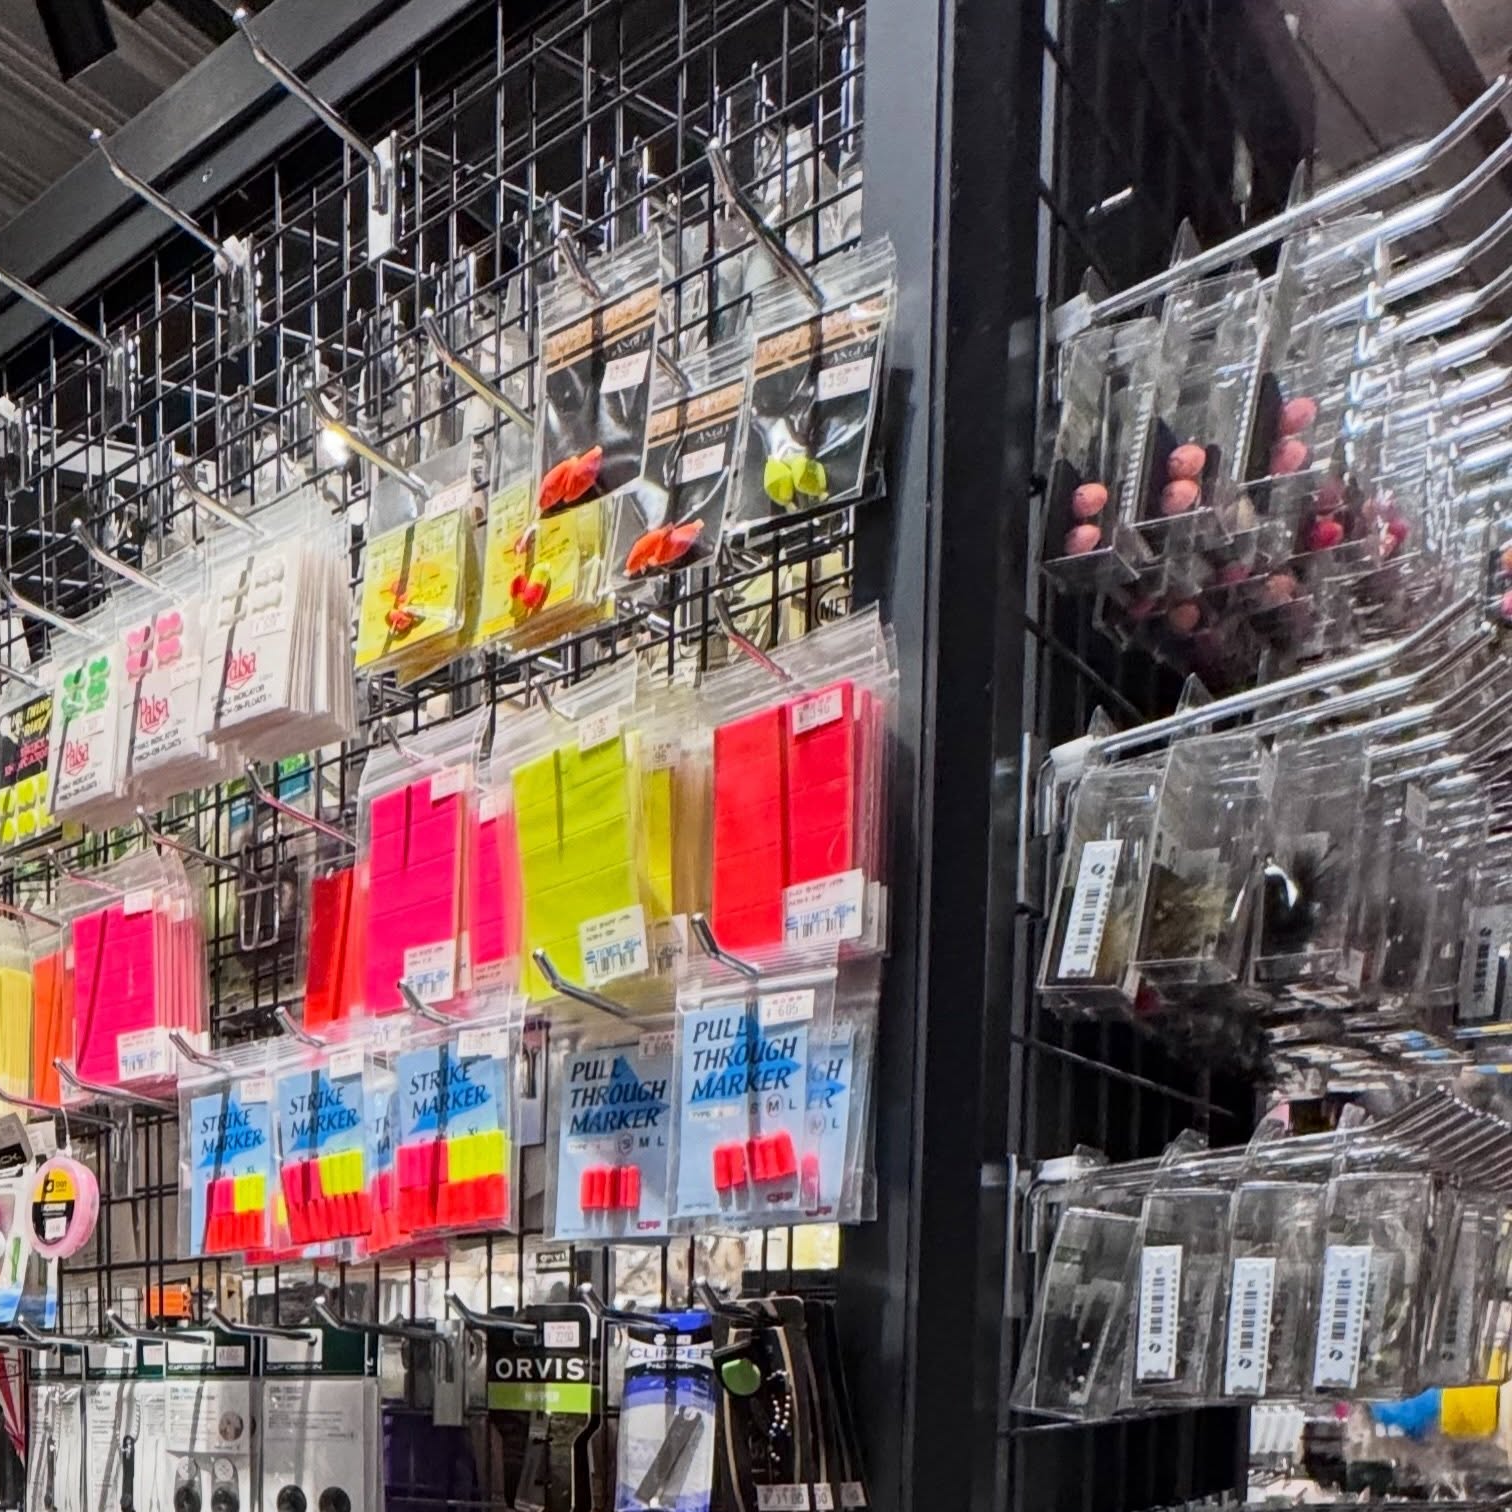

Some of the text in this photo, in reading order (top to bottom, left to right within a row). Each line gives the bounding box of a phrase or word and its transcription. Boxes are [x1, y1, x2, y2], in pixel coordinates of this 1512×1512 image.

[138, 693, 170, 731] Palsa
[693, 1015, 747, 1043] PULL
[693, 1037, 798, 1073] THROUGH
[409, 1062, 475, 1095] STRIKE
[570, 1059, 620, 1082] PULL
[691, 1065, 791, 1100] MARKER
[289, 1085, 346, 1116] STRIKE
[412, 1084, 487, 1119] MARKER
[570, 1080, 667, 1109] THROUGH
[767, 1100, 780, 1112] M
[788, 1099, 797, 1109] L
[201, 1108, 253, 1134] STRIKE
[291, 1107, 358, 1139] MARKER
[569, 1107, 659, 1135] MARKER
[201, 1128, 264, 1155] MARKER
[621, 1136, 665, 1149] S M L
[539, 1249, 569, 1262] ORVI
[630, 1348, 713, 1360] CLIPPER
[495, 1358, 585, 1381] ORVIS
